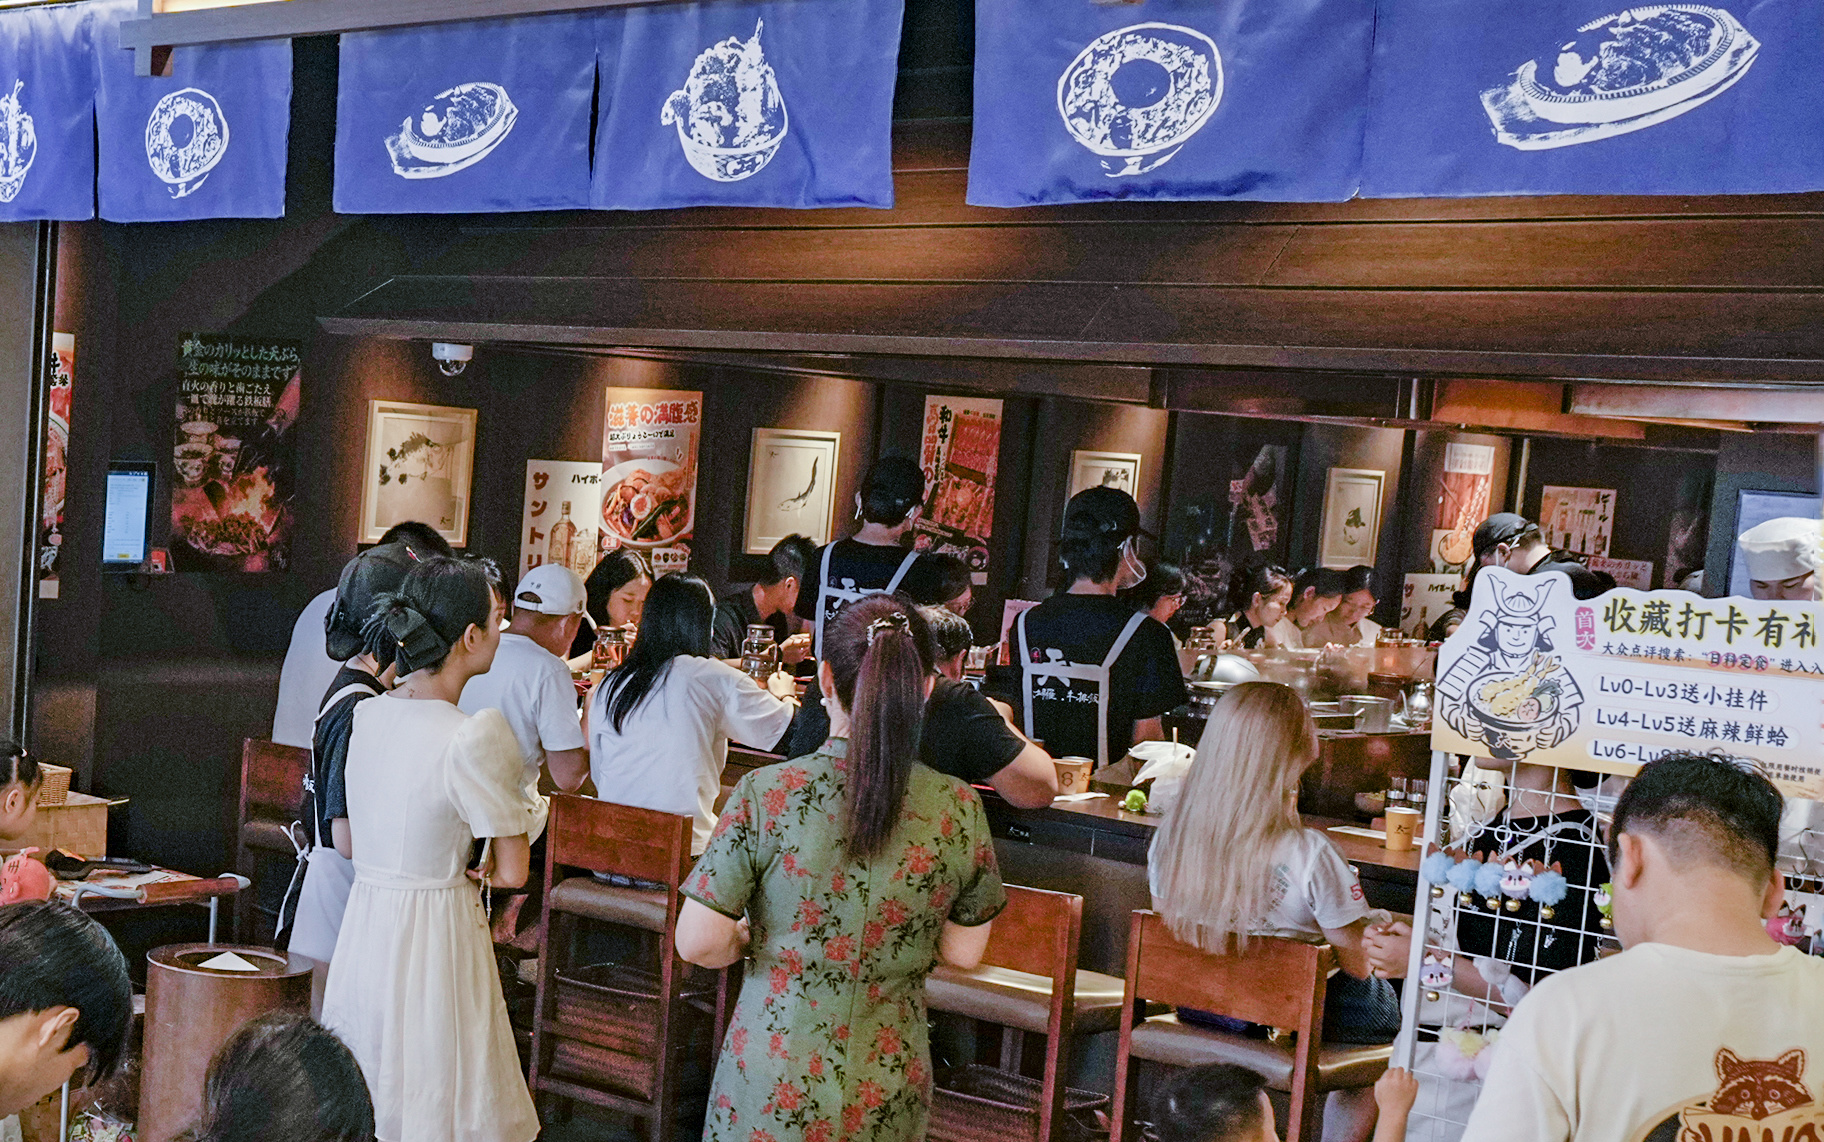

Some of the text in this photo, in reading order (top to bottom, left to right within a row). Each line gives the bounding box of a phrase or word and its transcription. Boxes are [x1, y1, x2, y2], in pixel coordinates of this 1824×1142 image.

[571, 473, 602, 485] ハイボ
[1575, 610, 1596, 650] 首次
[1600, 676, 1769, 713] Lv0-Lv3送小挂件
[1596, 708, 1790, 748] Lv4-Lv5送麻辣鲜蛤
